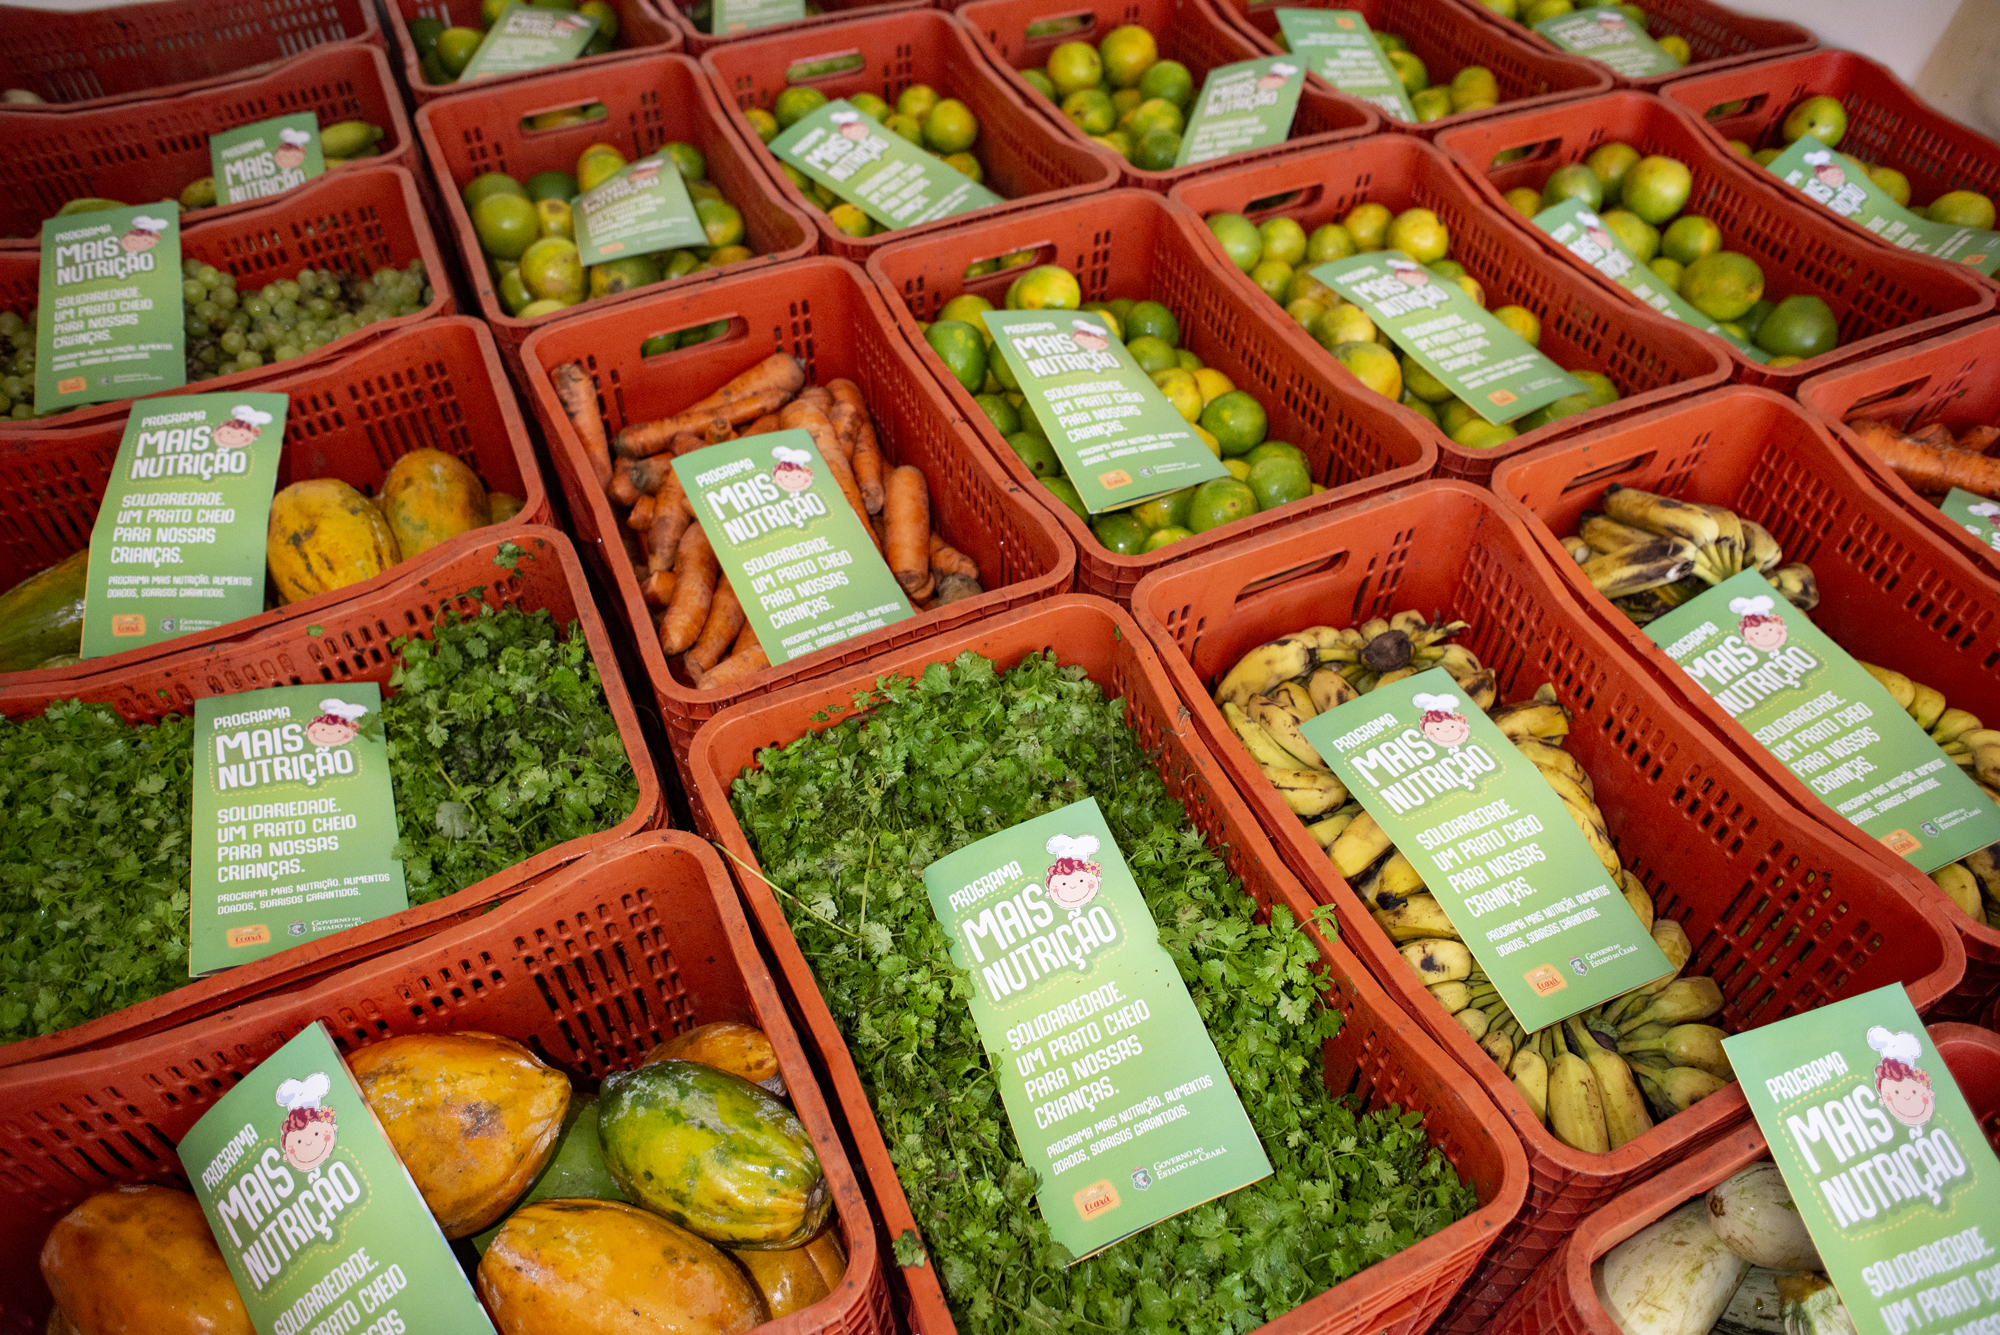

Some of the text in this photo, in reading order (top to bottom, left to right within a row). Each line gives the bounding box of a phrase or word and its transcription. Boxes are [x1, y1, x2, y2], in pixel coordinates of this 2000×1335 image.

[1011, 333, 1078, 358] MAIS
[1025, 348, 1121, 377] NUTRIÇÃO
[1043, 380, 1129, 402] SOLIDARIEDADE.
[1050, 391, 1145, 415] UM PRATO CHEIO
[134, 426, 212, 456] MAIS
[140, 412, 207, 428] PROGRAMA
[1058, 405, 1141, 428] PARA NOSSAS
[1066, 420, 1128, 453] CRIANÇAS.
[129, 447, 247, 481] NUTRIÇÃO
[695, 458, 756, 488] PROGRAMA
[117, 510, 236, 526] UM PRATO CHEIO
[121, 493, 226, 510] SOLIDARIEDADE.
[705, 473, 778, 520] MAIS
[721, 490, 826, 544] NUTRIÇÃO
[111, 546, 183, 566] CRIANÇAS.
[113, 527, 217, 544] PARA NOSSAS
[742, 536, 834, 577] SOLIDARIEDADE.
[751, 549, 852, 594] UM PRATO CHEIO
[759, 570, 848, 611] PARA NOSSAS
[768, 594, 834, 630] CRIANÇAS.
[1682, 635, 1758, 694] MAIS
[1713, 646, 1818, 718] NUTRIÇÃO
[212, 706, 291, 729] PROGRAMA
[1332, 714, 1399, 752] PROGRAMA
[1753, 691, 1846, 746] SOLIDARIEDADE.
[1770, 702, 1873, 761] UM PRATO CHEIO
[214, 723, 304, 763] MAIS
[1349, 728, 1436, 786] MAIS
[1790, 726, 1880, 778] PARA NOSSAS
[217, 746, 353, 790] NUTRIÇÃO
[1378, 744, 1495, 815] NUTRIÇÃO
[1810, 756, 1878, 794] CRIANÇAS.
[217, 797, 342, 826] SOLIDARIEDADE.
[217, 814, 357, 844] UM PRATO CHEIO
[1416, 800, 1518, 853] SOLIDARIEDADE.
[217, 836, 339, 863] PARA NOSSAS
[1432, 816, 1543, 874] UM PRATO CHEIO
[1447, 844, 1546, 895] PARA NOSSAS
[217, 857, 305, 883] CRIANÇAS.
[217, 874, 390, 903] PROGRAMA MAIS NUTRIÇÃO. ALIMENTOS
[948, 860, 1023, 913] PROGRAMA
[217, 888, 361, 916] DOADOS, SORRISOS GARANTIDOS.
[1463, 875, 1537, 918] CRIANÇAS.
[1485, 884, 1611, 943] PROGRAMA MAIS NUTRIÇÃO. ALIMENTOS
[961, 883, 1054, 963] MAIS
[1495, 905, 1601, 958] DOADOS, SORRISOS GARANTIDOS.
[981, 906, 1117, 1002] NUTRIÇÃO
[1005, 980, 1127, 1051] SOLIDARIEDADE.
[1015, 998, 1150, 1077] UM PRATO CHEIO
[1024, 1034, 1143, 1102] PARA NOSSAS
[1765, 1051, 1850, 1104] PROGRAMA
[1033, 1075, 1120, 1129] CRIANÇAS.
[1046, 1074, 1213, 1158] PROGRAMA MAIS NUTRIÇÃO. ALIMENTOS
[1052, 1103, 1190, 1175] DOADOS, SORRISOS GARANTIDOS.
[1786, 1084, 1893, 1174] MAIS
[200, 1123, 259, 1194] PROGRAMA
[1818, 1125, 1966, 1228] NUTRIÇÃO
[216, 1146, 294, 1249] MAIS
[240, 1159, 360, 1291] NUTRIÇÃO
[1861, 1226, 1995, 1298] SOLIDARIEDADE.
[311, 1300, 360, 1335] RATO
[358, 1264, 407, 1313] CHEIO
[1880, 1298, 1922, 1335] UM
[1916, 1276, 1980, 1322] PRATO
